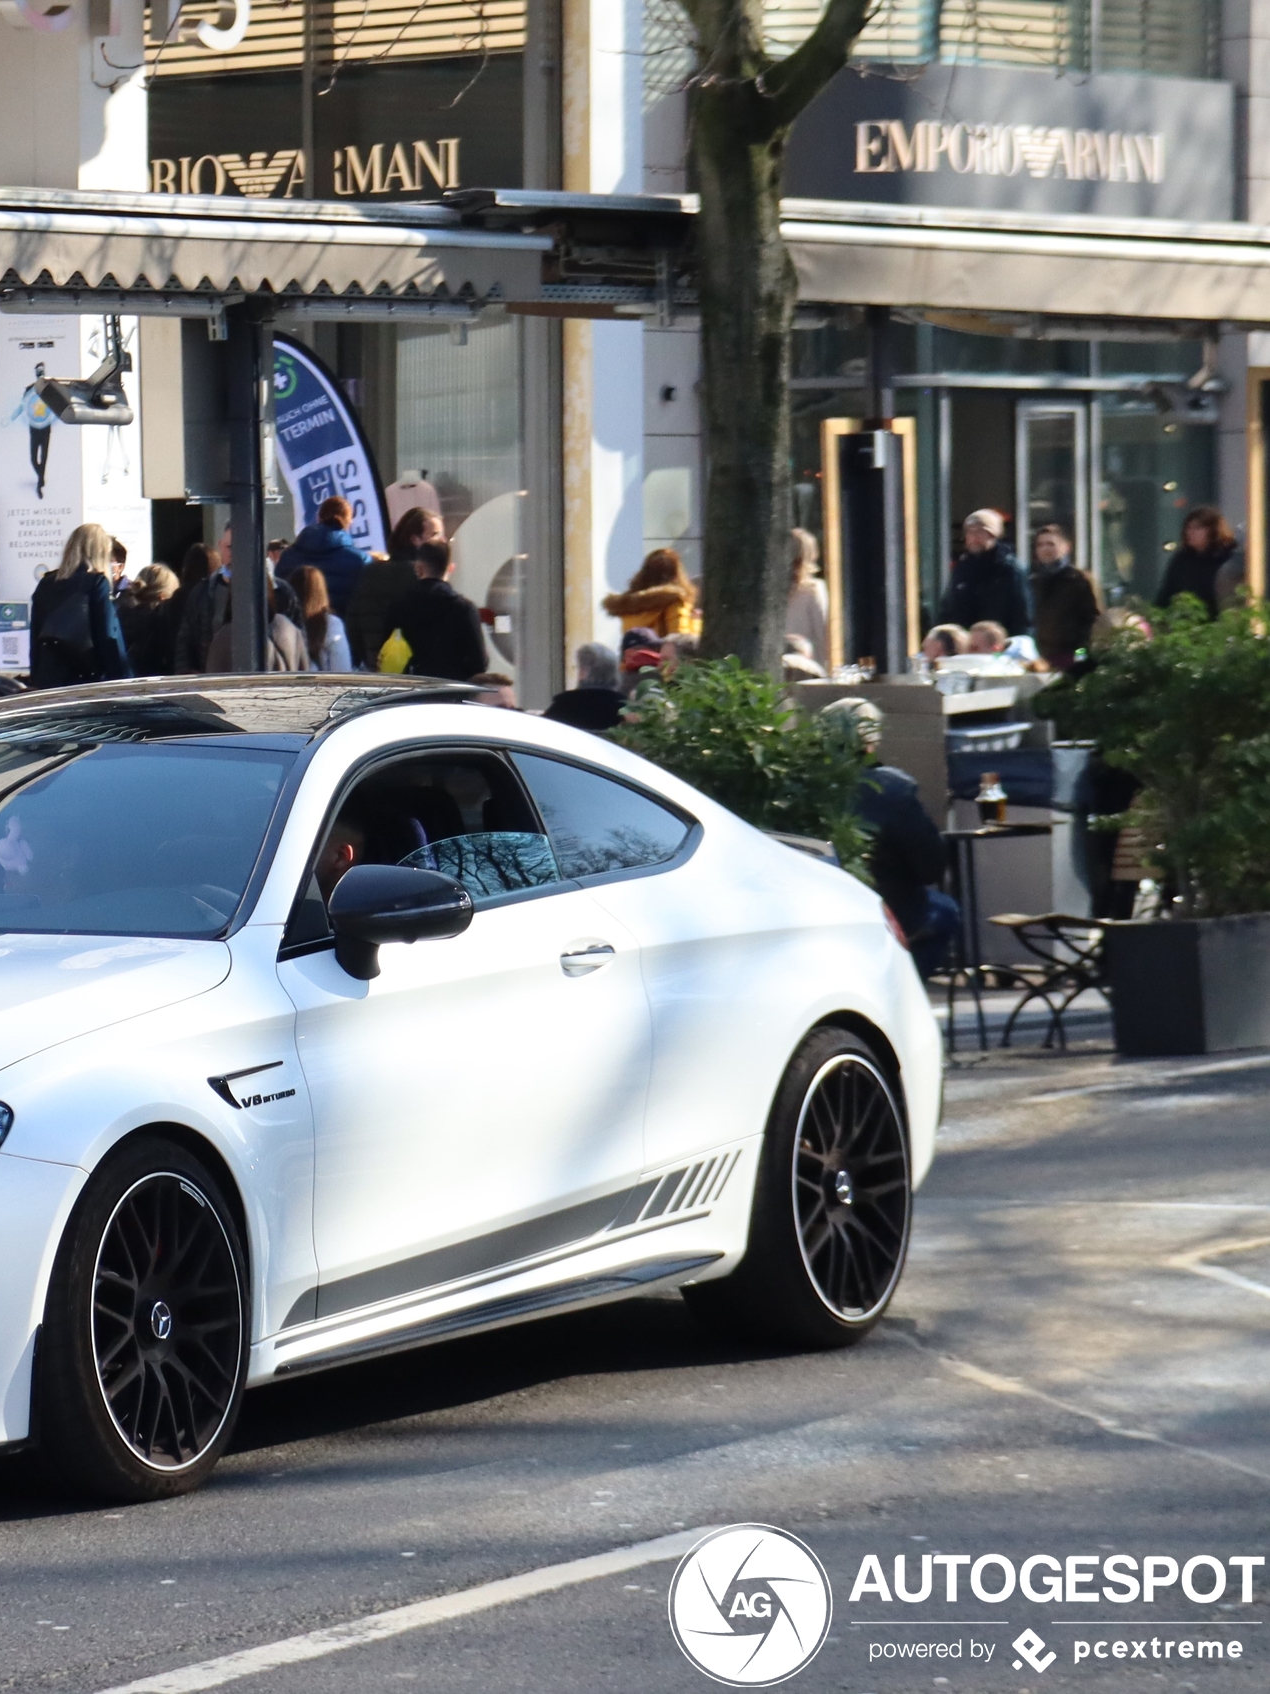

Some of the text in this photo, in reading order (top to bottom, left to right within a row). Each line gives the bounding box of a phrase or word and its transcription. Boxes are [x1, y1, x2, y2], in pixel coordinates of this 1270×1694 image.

[853, 120, 1166, 184] EMPORIO ARMANI
[301, 394, 330, 413] OHNE
[280, 407, 336, 442] TERMIN
[7, 507, 72, 517] JETZT MITGLIED
[19, 518, 53, 527] WERDEN
[17, 529, 62, 538] EXKLUSIVE
[9, 540, 64, 549] BELOHNUNGE
[240, 1088, 296, 1109] V8 BITURBO
